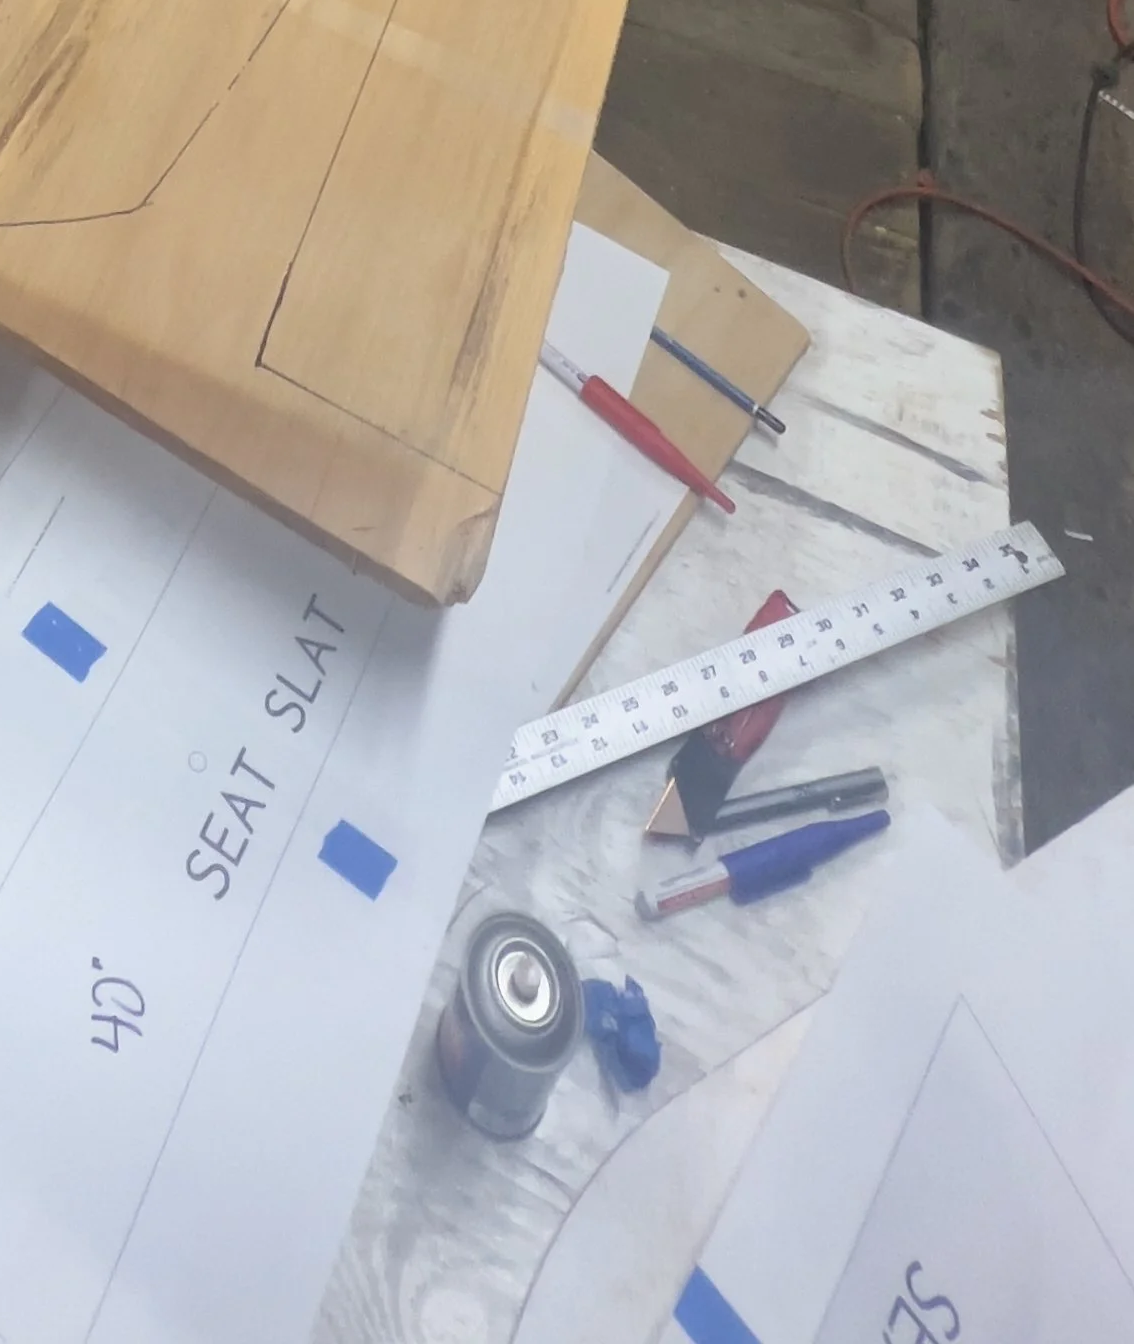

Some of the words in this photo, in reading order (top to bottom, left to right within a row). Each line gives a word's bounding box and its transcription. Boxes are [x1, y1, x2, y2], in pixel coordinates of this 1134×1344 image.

[541, 729, 559, 745] 23
[582, 713, 600, 729] 24
[622, 696, 640, 712] 25
[661, 680, 679, 697] 26
[701, 665, 717, 680] 27
[739, 649, 757, 664] 28
[777, 633, 795, 649] 29
[816, 618, 833, 633] 30
[852, 603, 870, 618] 31
[889, 587, 907, 602] 32
[962, 557, 980, 572] 34
[185, 745, 276, 901] SEAT
[264, 592, 346, 733] SLAT
[882, 1260, 961, 1344] SE
